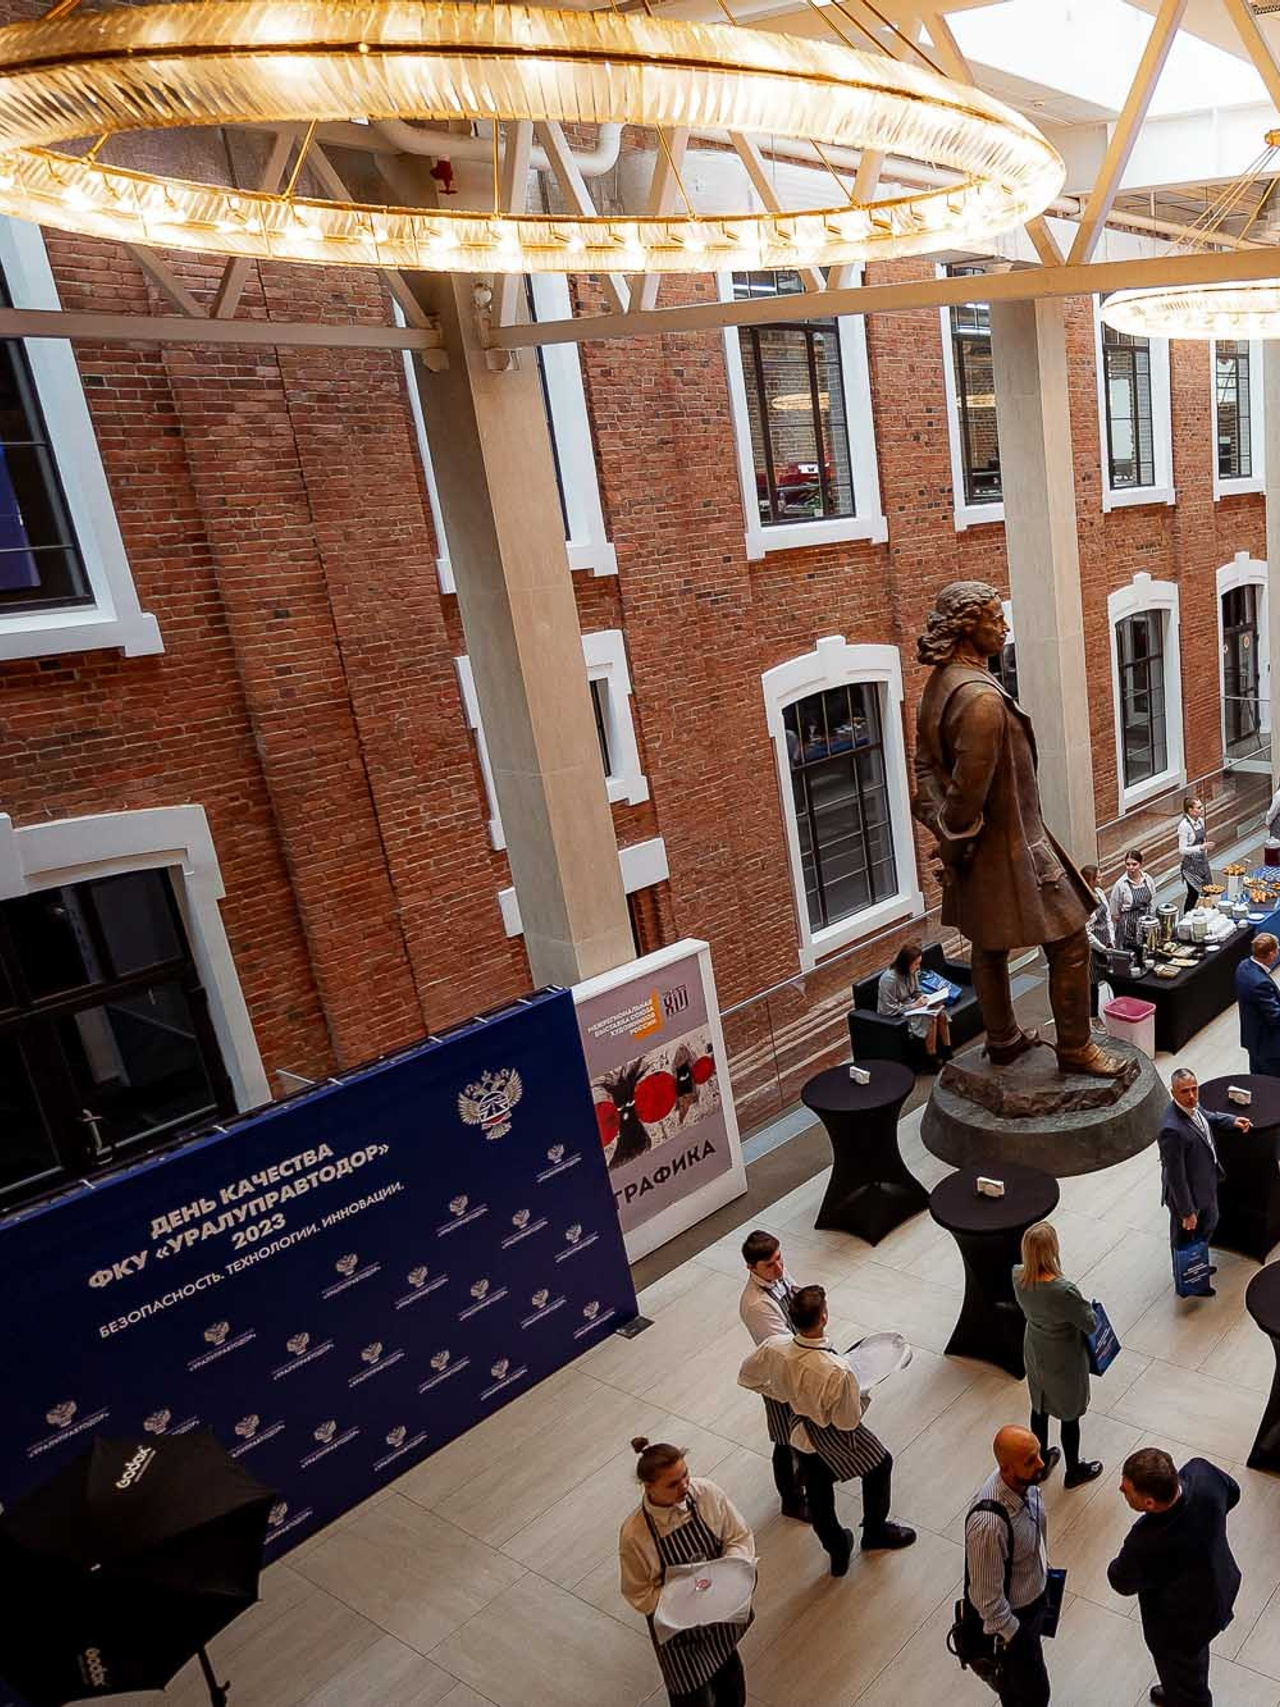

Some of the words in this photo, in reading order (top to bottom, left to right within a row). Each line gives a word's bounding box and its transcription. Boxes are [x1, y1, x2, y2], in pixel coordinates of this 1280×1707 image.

[88, 1250, 149, 1289] ФКУ
[155, 1143, 390, 1260] «УРАЛУПРАВТОДОР»
[150, 1198, 217, 1240] ДЕНЬ
[220, 1142, 334, 1206] КАЧЕСТВА
[231, 1212, 287, 1250] 2023
[99, 1270, 225, 1338] БЕЗОПАСНОСТЬ.
[225, 1224, 320, 1275] ТЕХНОЛОГИИ.
[321, 1180, 405, 1228] ИННОВАЦИИ.
[115, 1445, 152, 1489] Godox
